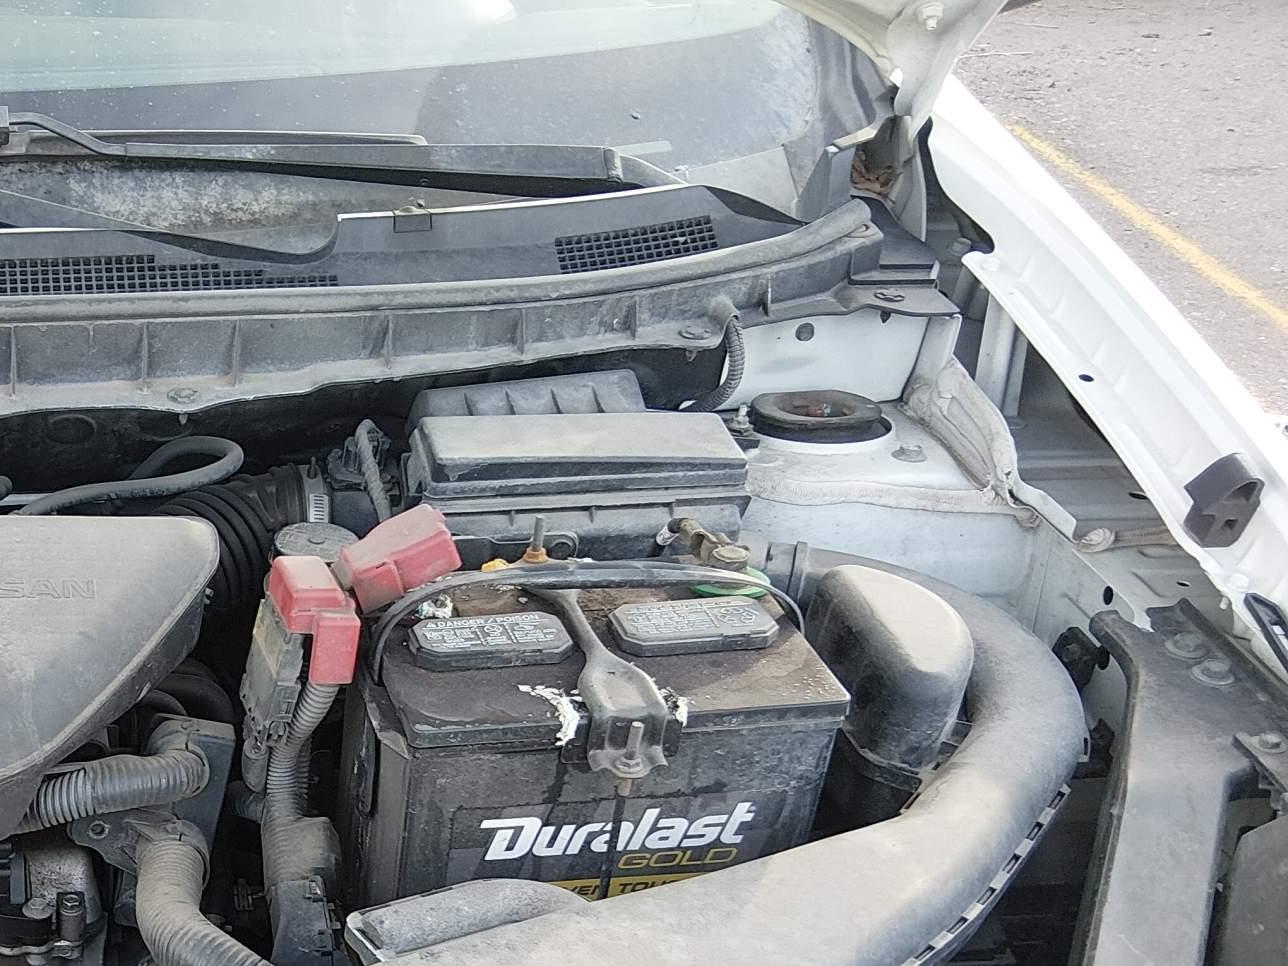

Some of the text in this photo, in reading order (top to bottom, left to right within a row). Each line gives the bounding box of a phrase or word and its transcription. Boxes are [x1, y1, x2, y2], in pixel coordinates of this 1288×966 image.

[437, 618, 485, 628] DANGER
[496, 614, 540, 623] POISON
[480, 802, 756, 861] Duralast
[617, 847, 738, 869] GOLD
